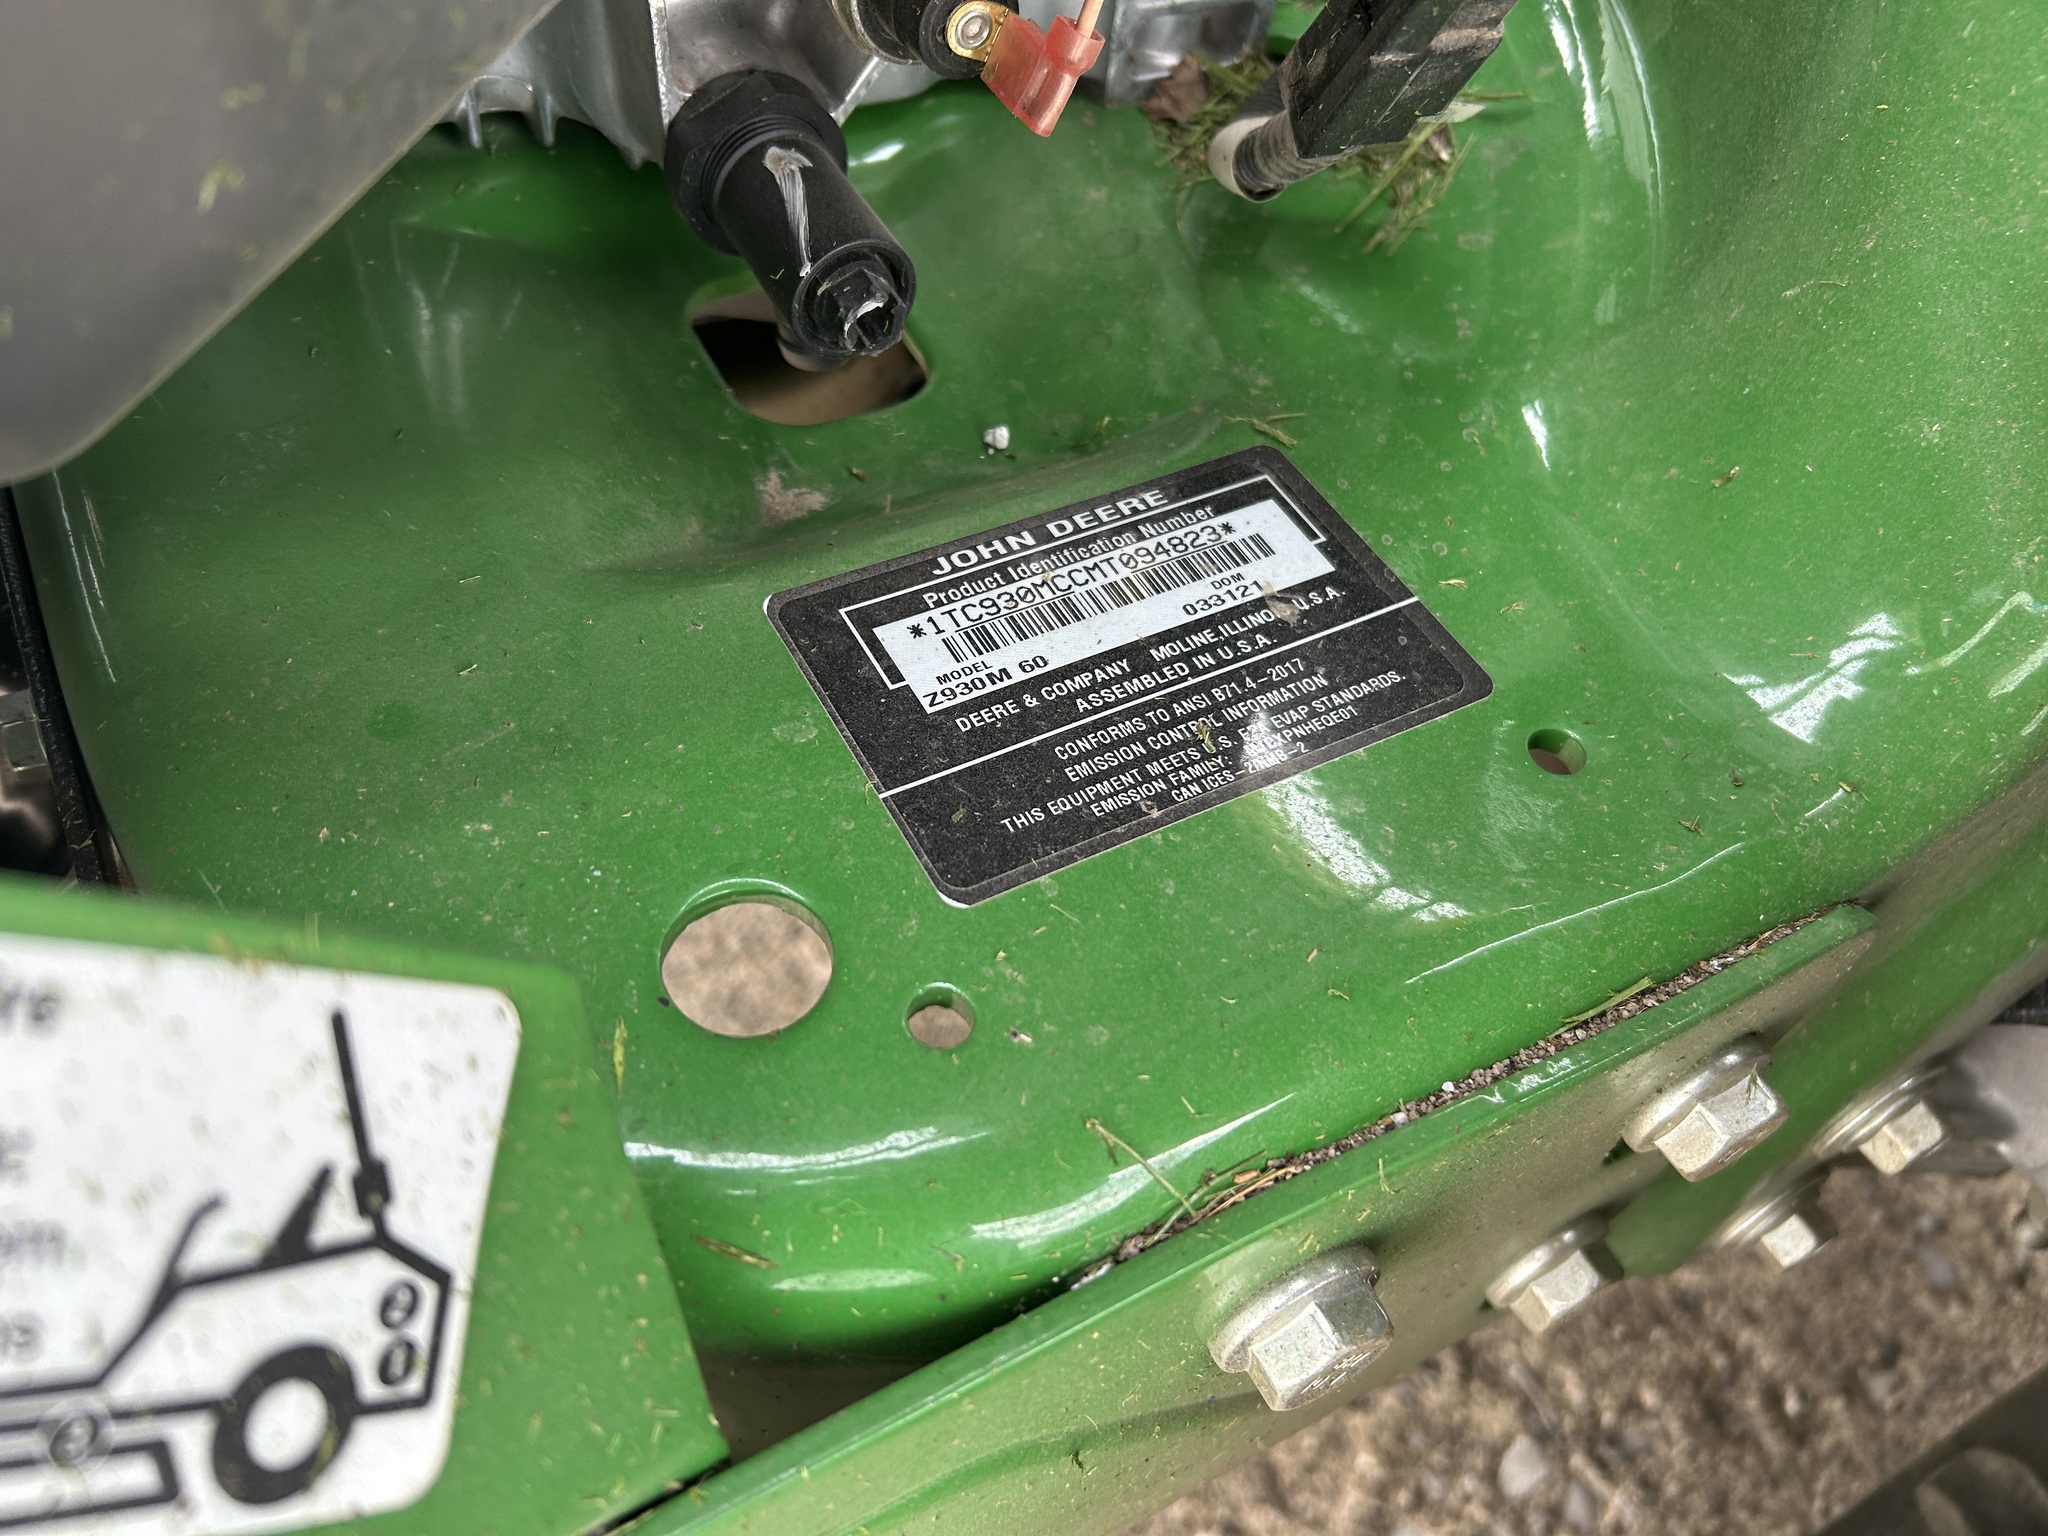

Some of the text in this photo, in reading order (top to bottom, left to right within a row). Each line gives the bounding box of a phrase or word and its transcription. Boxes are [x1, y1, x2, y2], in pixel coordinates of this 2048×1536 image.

[922, 506, 1219, 608] Product Identification Number
[932, 489, 1168, 574] JOHN DEERE
[1181, 580, 1263, 615] 033121
[1210, 572, 1245, 589] DOM
[922, 655, 1048, 707] Z930M 60
[935, 660, 993, 685] MODEL
[954, 699, 1020, 732] DEERE
[1022, 693, 1040, 707] &
[1040, 658, 1130, 700] COMPANY
[1291, 586, 1345, 609] U.S.A.
[1075, 633, 1277, 712] ASSEMBLED IN U.S.A.
[999, 807, 1044, 832] THIS
[1046, 768, 1142, 815] EQUIPMENT
[1144, 747, 1200, 776] MEETS
[1269, 705, 1308, 728] EVAP
[1311, 671, 1405, 712] STANDARDS.
[1054, 717, 1146, 759] CONFORMS
[1144, 708, 1170, 724] TO
[1172, 692, 1211, 716] ANSI
[1064, 741, 1146, 781] EMISSION
[1221, 671, 1328, 721] INFORMATION
[1089, 778, 1167, 815] EMISSION
[1167, 754, 1232, 785] FAMILY:
[1171, 781, 1206, 805] CAN
